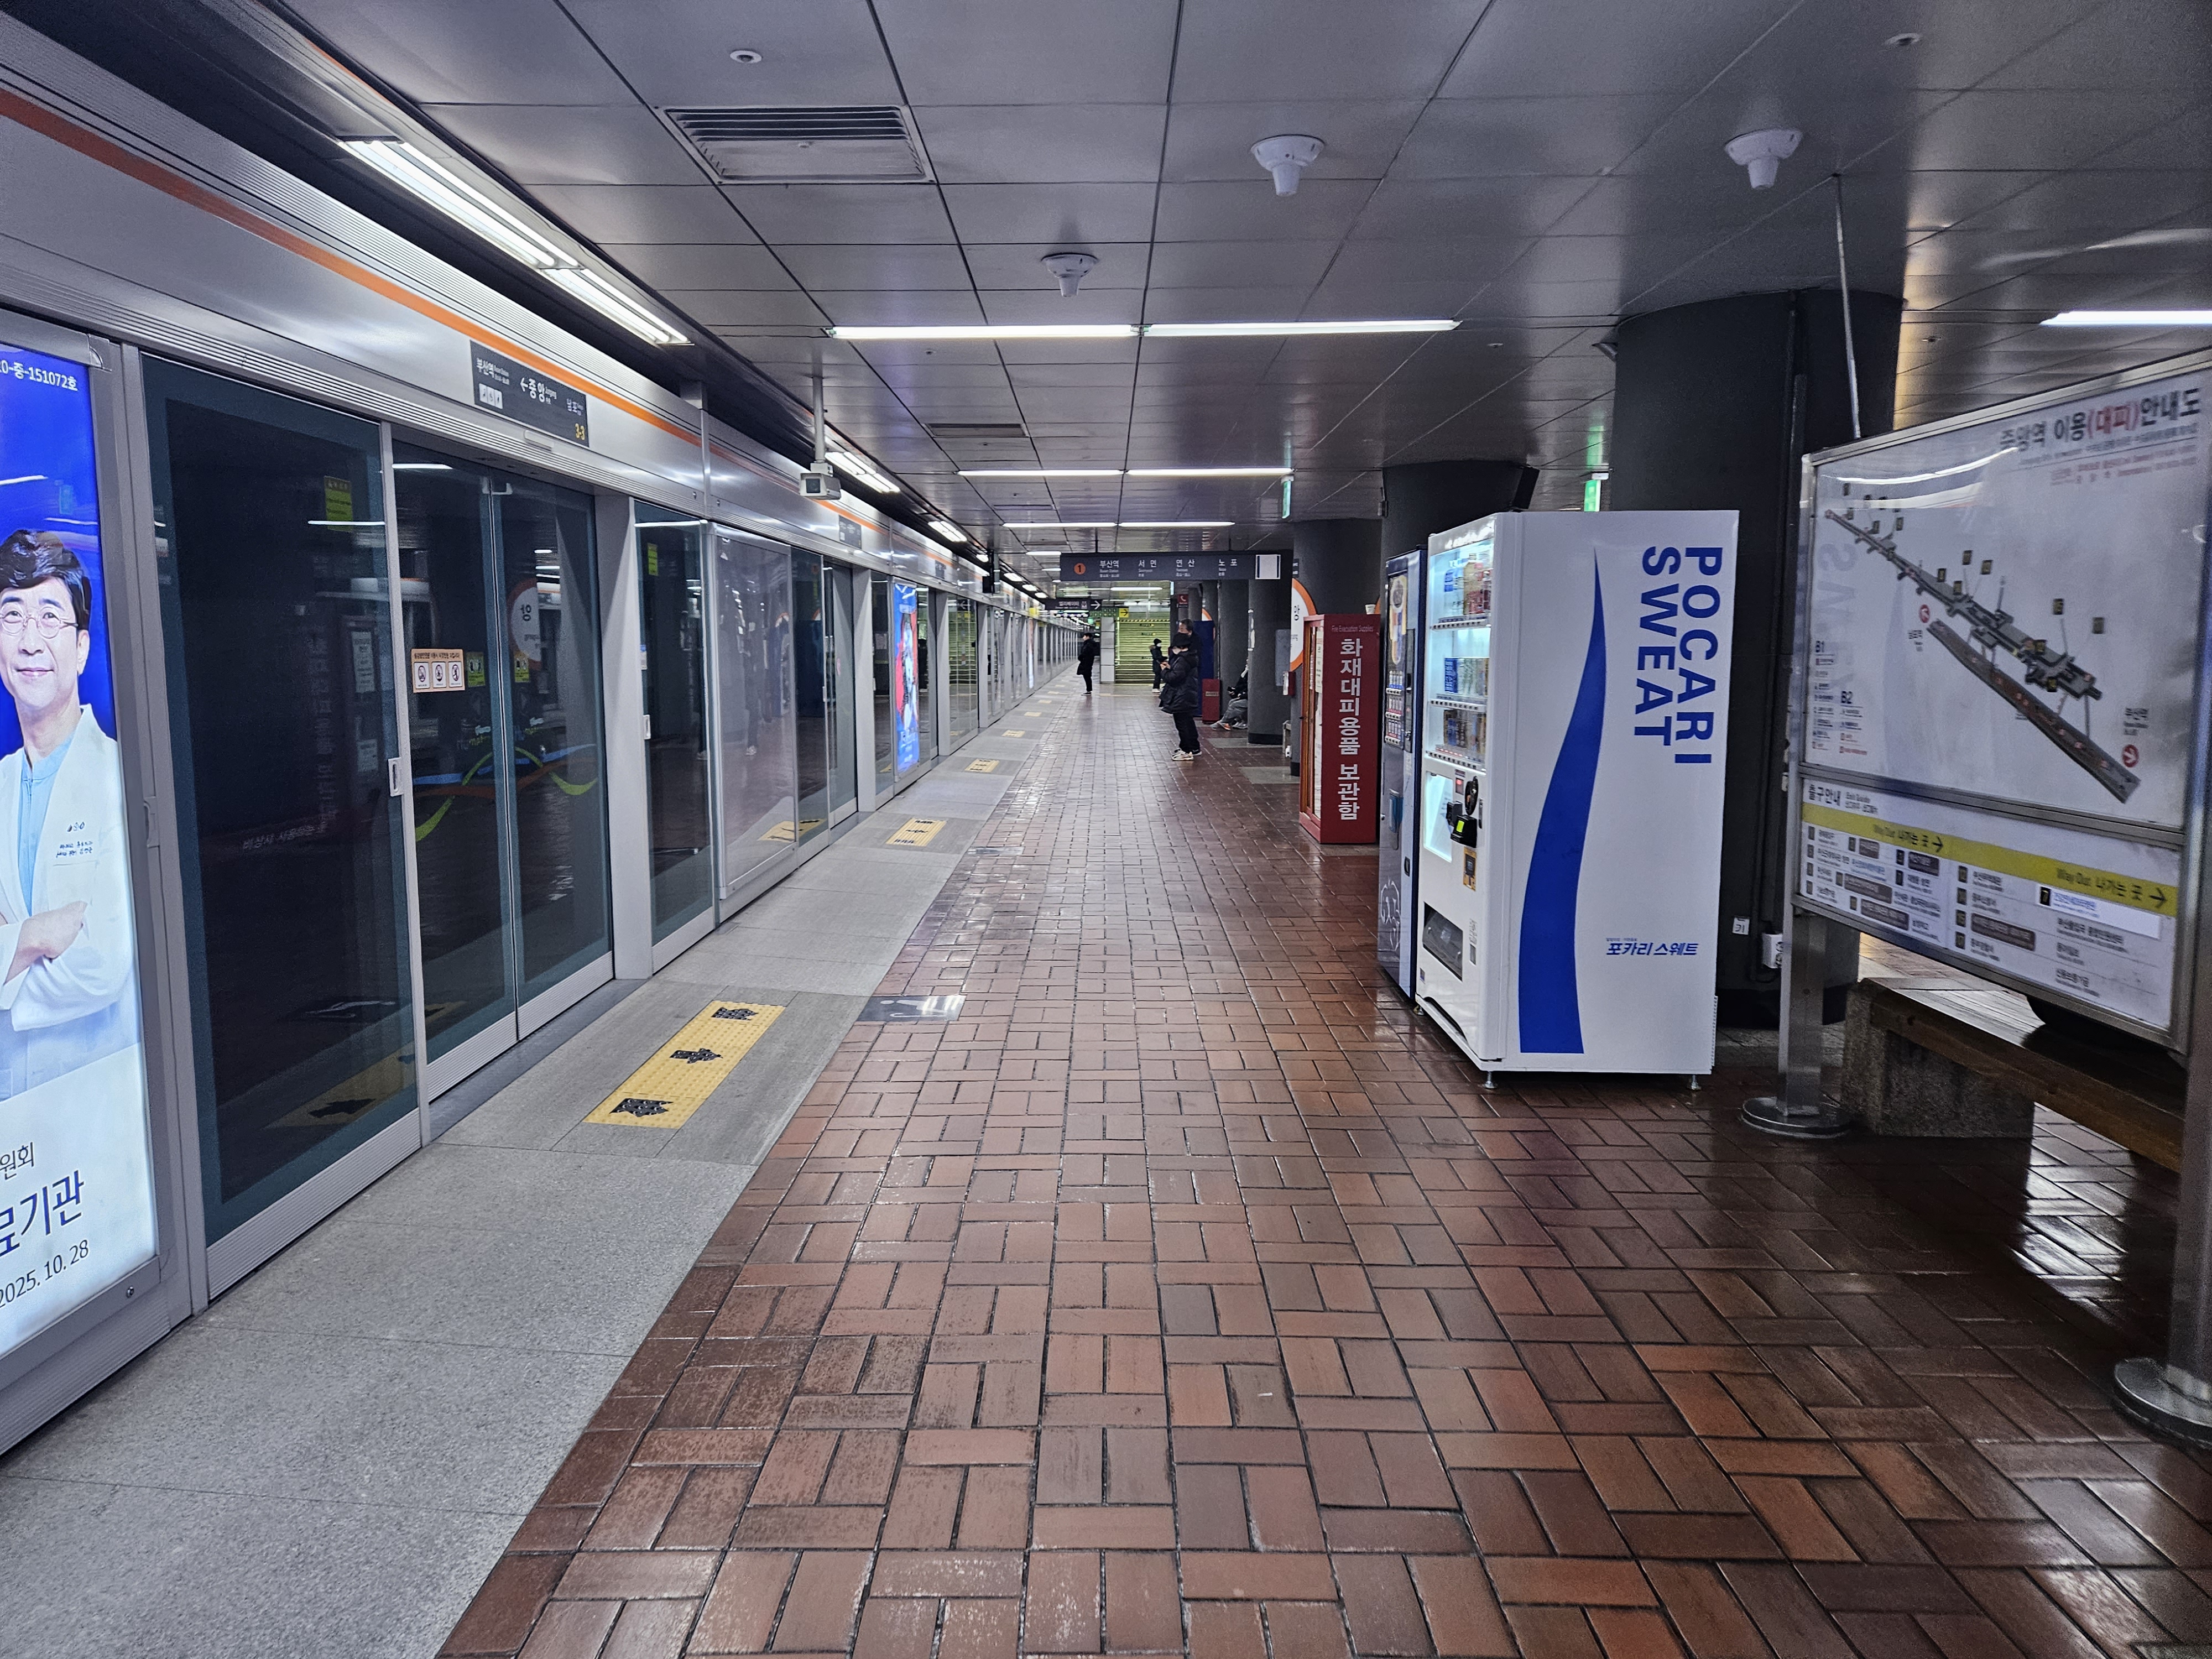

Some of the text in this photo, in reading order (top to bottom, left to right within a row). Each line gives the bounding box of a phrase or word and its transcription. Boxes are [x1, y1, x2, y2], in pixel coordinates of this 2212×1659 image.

[529, 378, 545, 403] 중앙
[575, 423, 586, 440] 3-3
[1099, 560, 1119, 568] 부산역
[1634, 545, 1681, 746] SWEAT
[1673, 546, 1723, 764] POCARI
[1841, 691, 1854, 705] B2
[1337, 638, 1363, 820] 화재대피용품 보관함
[1808, 785, 1841, 806] 출구안내
[1606, 942, 1699, 956] 포카리 스웨트
[70, 1239, 89, 1265] 28
